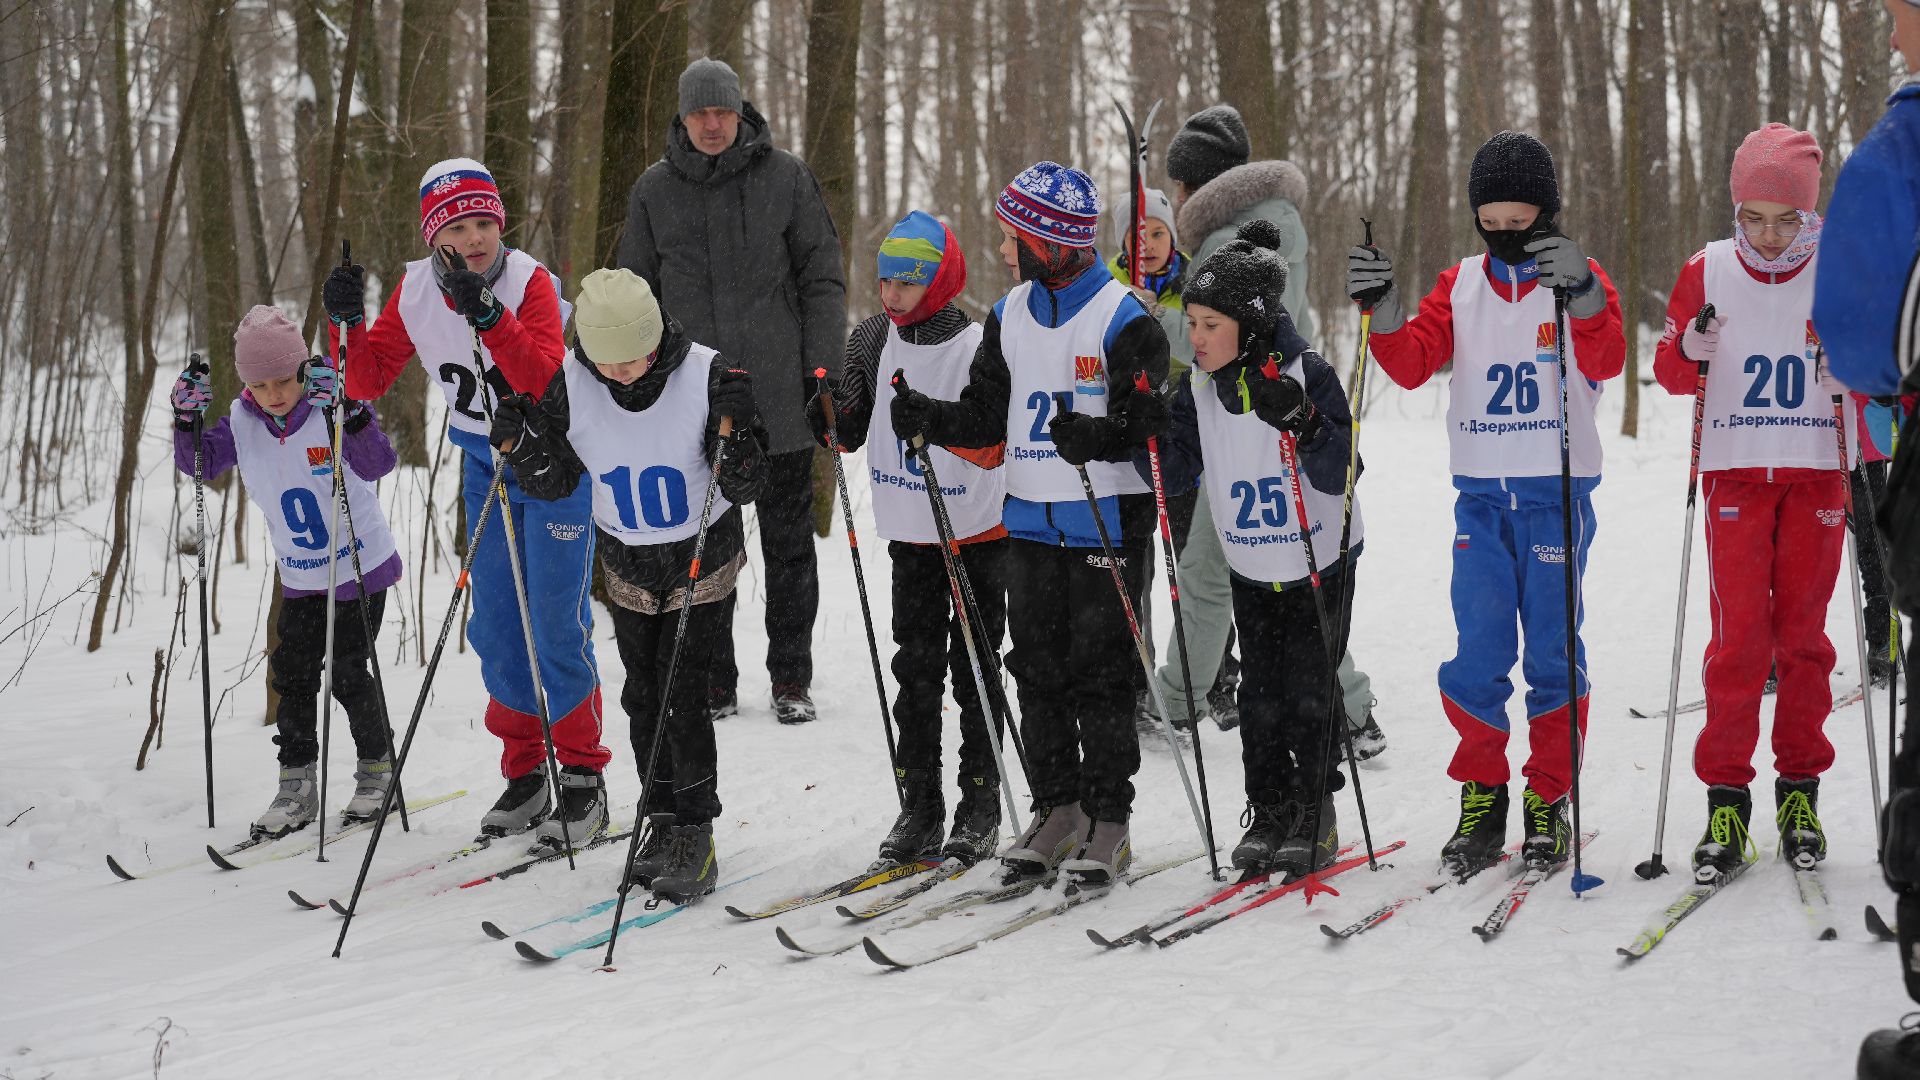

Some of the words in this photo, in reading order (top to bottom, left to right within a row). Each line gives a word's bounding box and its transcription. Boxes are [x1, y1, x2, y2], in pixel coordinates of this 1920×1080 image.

[457, 197, 503, 213] РОСС
[1487, 362, 1540, 415] 26
[1743, 355, 1805, 409] 20
[1460, 422, 1468, 431] г.
[1713, 420, 1725, 428] г.
[1729, 414, 1838, 429] Дзержинский
[600, 465, 688, 530] 10
[1149, 451, 1166, 516] MADSHUS
[1231, 477, 1288, 529] 25
[281, 488, 330, 551] 9
[1532, 544, 1575, 554] GONK
[1538, 552, 1565, 562] SKINS
